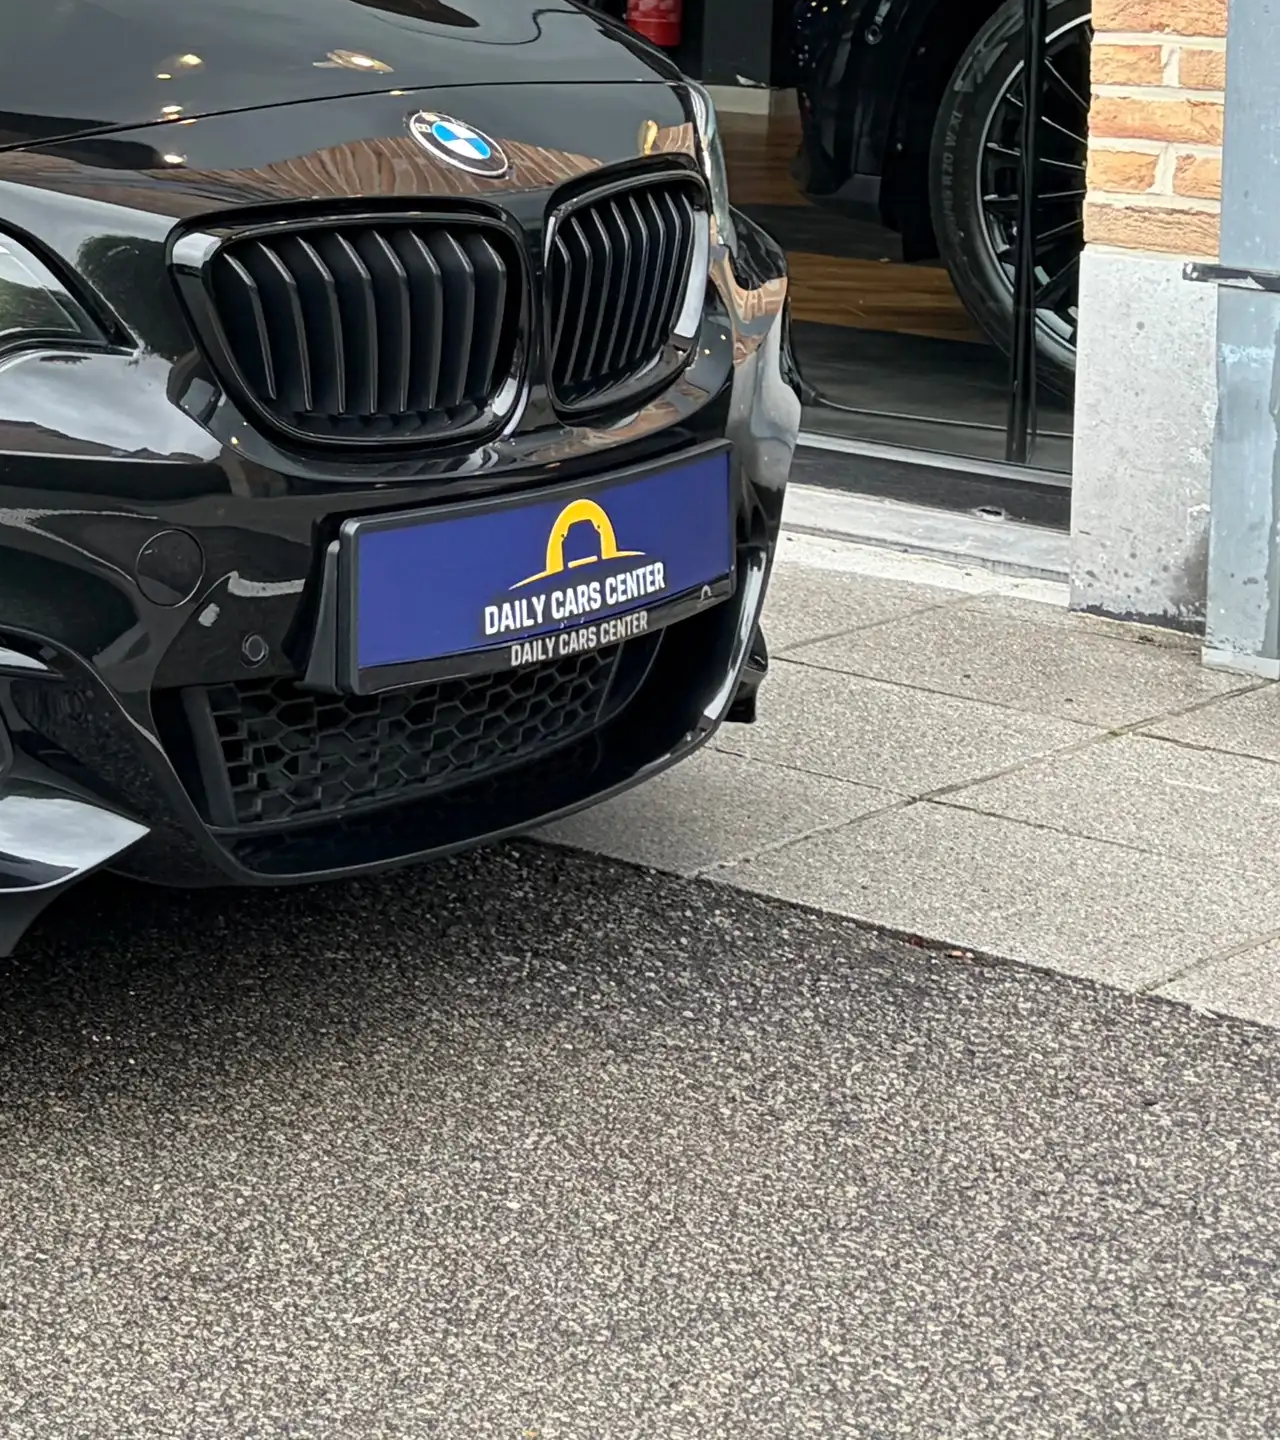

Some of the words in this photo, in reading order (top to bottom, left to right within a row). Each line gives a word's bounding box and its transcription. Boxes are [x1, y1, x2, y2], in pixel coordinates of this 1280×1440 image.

[484, 594, 545, 635] DAILY
[551, 582, 601, 620] CARS
[606, 562, 665, 605] CENTER
[511, 639, 555, 667] DAILY
[559, 627, 597, 656] CARS
[600, 612, 648, 643] CENTER
